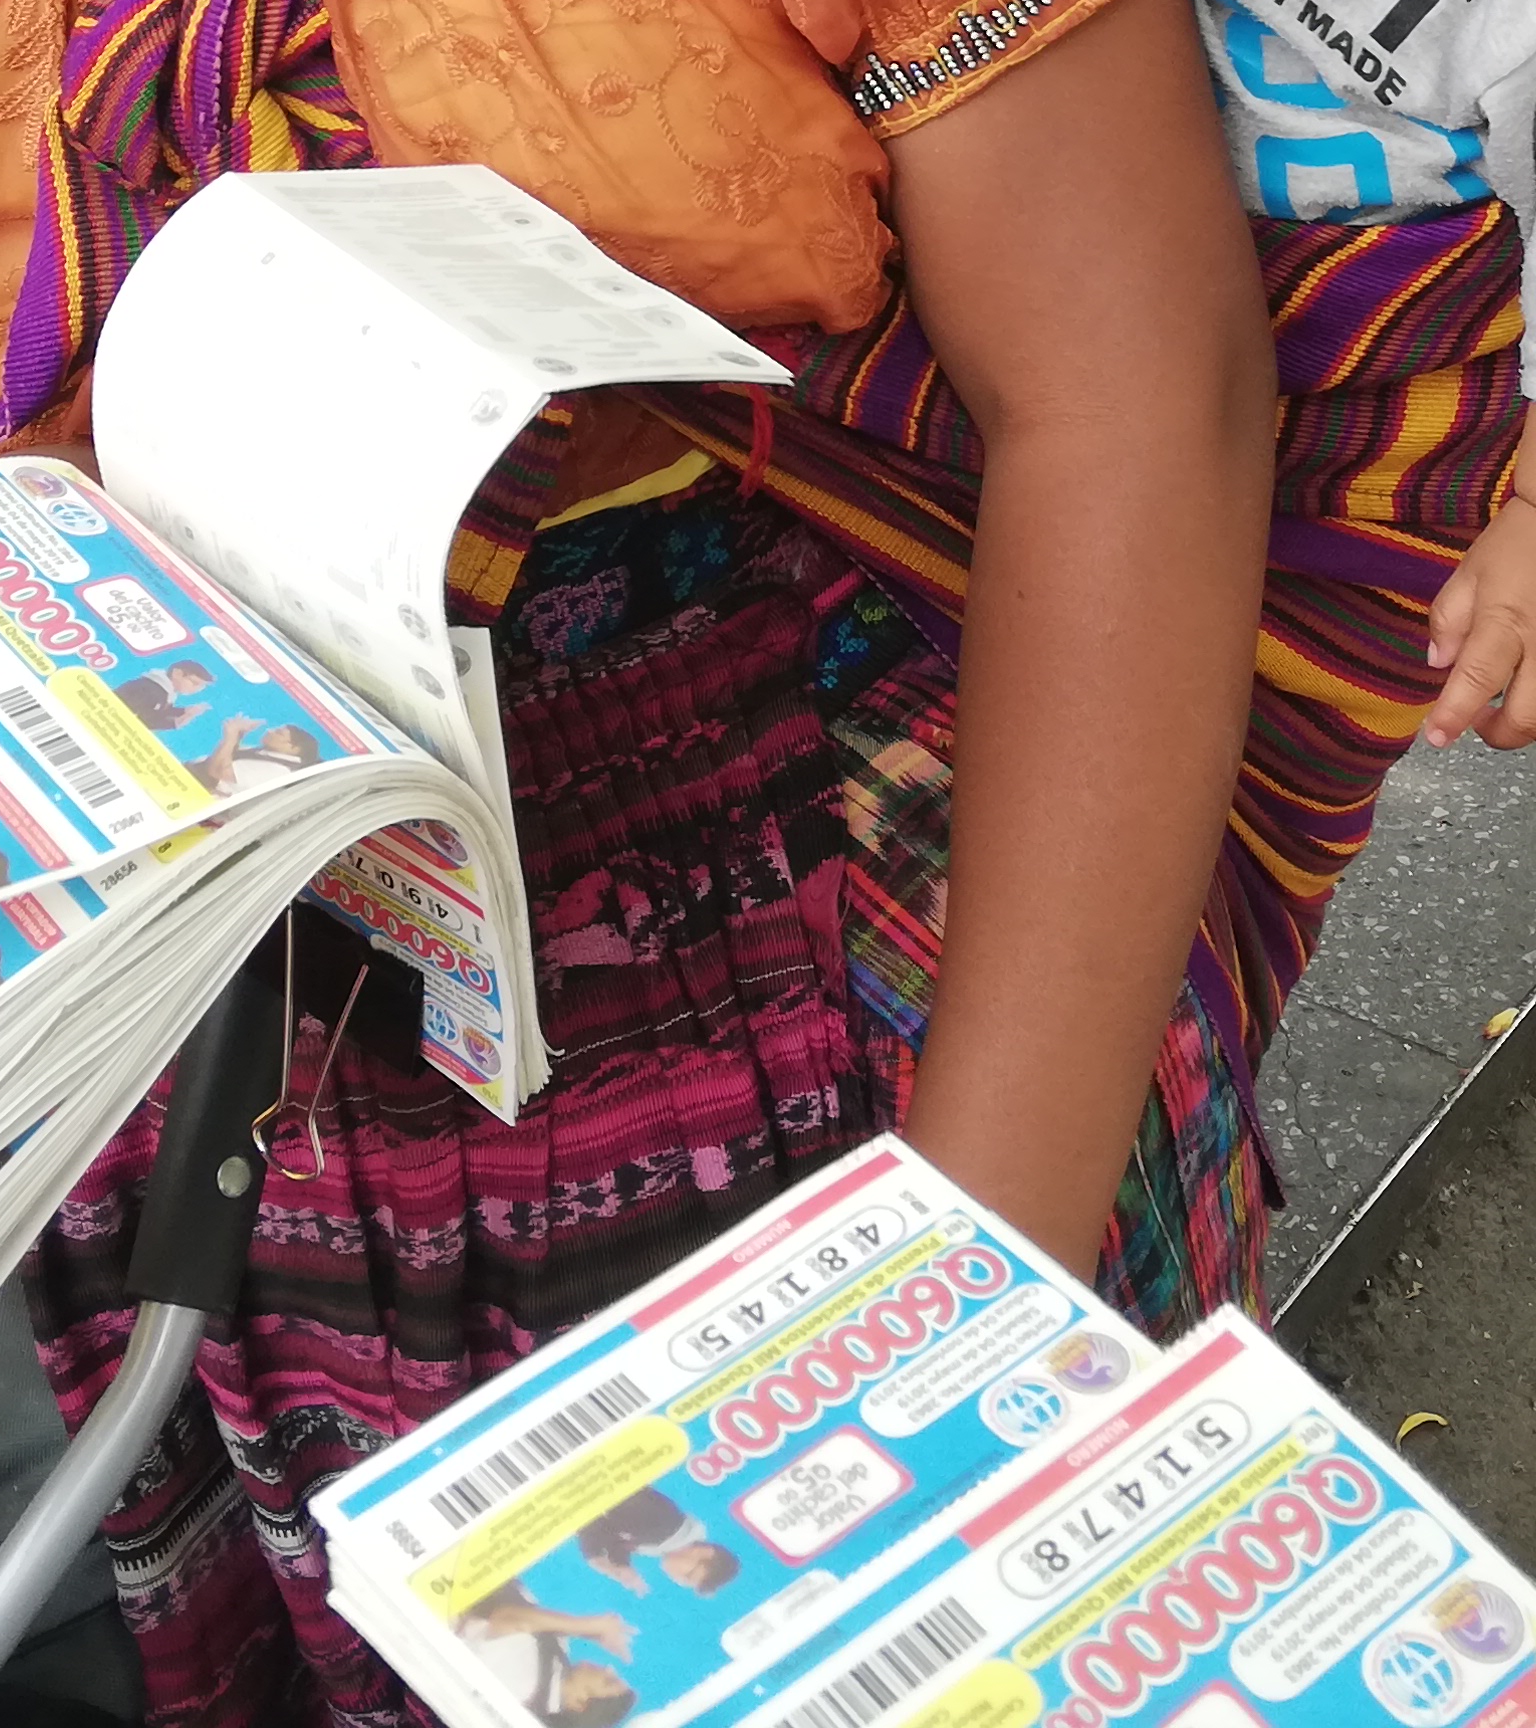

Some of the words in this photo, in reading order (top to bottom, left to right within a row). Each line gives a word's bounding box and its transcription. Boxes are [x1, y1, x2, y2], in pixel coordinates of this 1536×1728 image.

[107, 588, 132, 605] del
[121, 602, 168, 641] cachito
[134, 596, 170, 625] Valor
[1, 625, 54, 672] Quetzales
[98, 856, 139, 894] 28656
[332, 850, 451, 922] 4907
[881, 1235, 944, 1278] Premio
[859, 1271, 889, 1293] de
[774, 1286, 868, 1349] Seiscientos
[748, 1343, 782, 1367] Mil
[668, 1359, 757, 1419] Quetzales
[831, 1459, 872, 1489] del
[1236, 1442, 1300, 1494] Premio
[765, 1478, 845, 1534] cachito
[811, 1490, 866, 1530] Valor
[1215, 1486, 1245, 1511] de
[1127, 1502, 1223, 1579] Seiscientos
[1365, 1508, 1417, 1552] Caduca
[1332, 1557, 1357, 1579] de
[1349, 1543, 1374, 1565] 04
[1366, 1536, 1421, 1582] Sábado
[1392, 1552, 1440, 1592] Sorteo
[1101, 1572, 1135, 1600] Mil
[1265, 1570, 1340, 1632] noviembre
[1333, 1586, 1359, 1609] de
[1350, 1572, 1376, 1595] 04
[1016, 1590, 1107, 1664] Quetzales
[1295, 1597, 1342, 1636] mayo
[1335, 1584, 1402, 1640] Ordinario
[1234, 1624, 1274, 1658] 2019
[1266, 1629, 1307, 1664] 2019
[1313, 1631, 1344, 1658] No.
[1281, 1649, 1322, 1684] 2863
